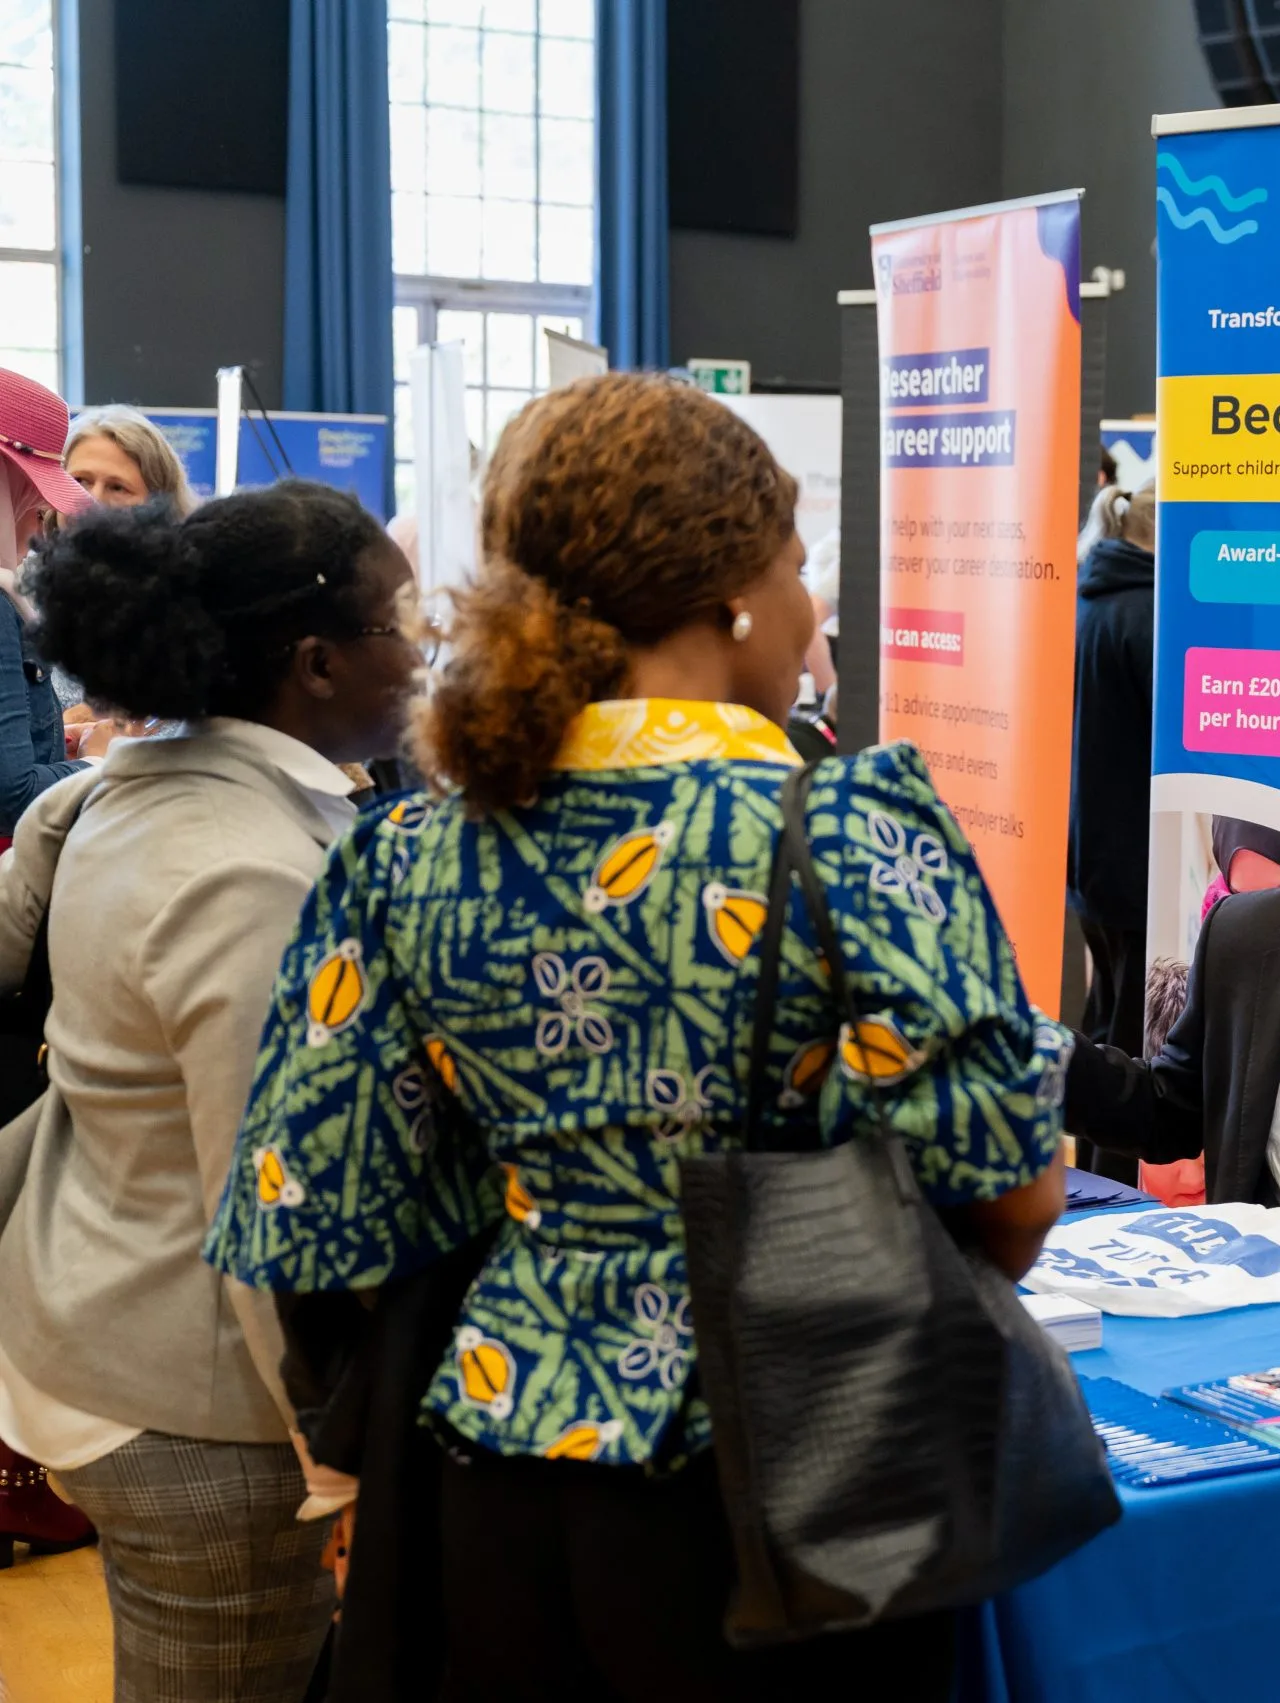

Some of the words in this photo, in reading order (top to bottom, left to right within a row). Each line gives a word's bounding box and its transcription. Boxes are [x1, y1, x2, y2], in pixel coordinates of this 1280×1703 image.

[883, 427, 939, 456] areer
[941, 418, 1011, 464] support
[1172, 460, 1232, 479] Support
[895, 628, 919, 649] can
[921, 630, 961, 652] access:
[1200, 674, 1245, 696] Earn
[902, 693, 940, 719] advice
[942, 700, 1009, 731] appointments
[1199, 710, 1231, 731] per
[1235, 709, 1280, 731] hour
[946, 749, 965, 772] and
[966, 757, 998, 780] events
[1000, 812, 1024, 838] talks
